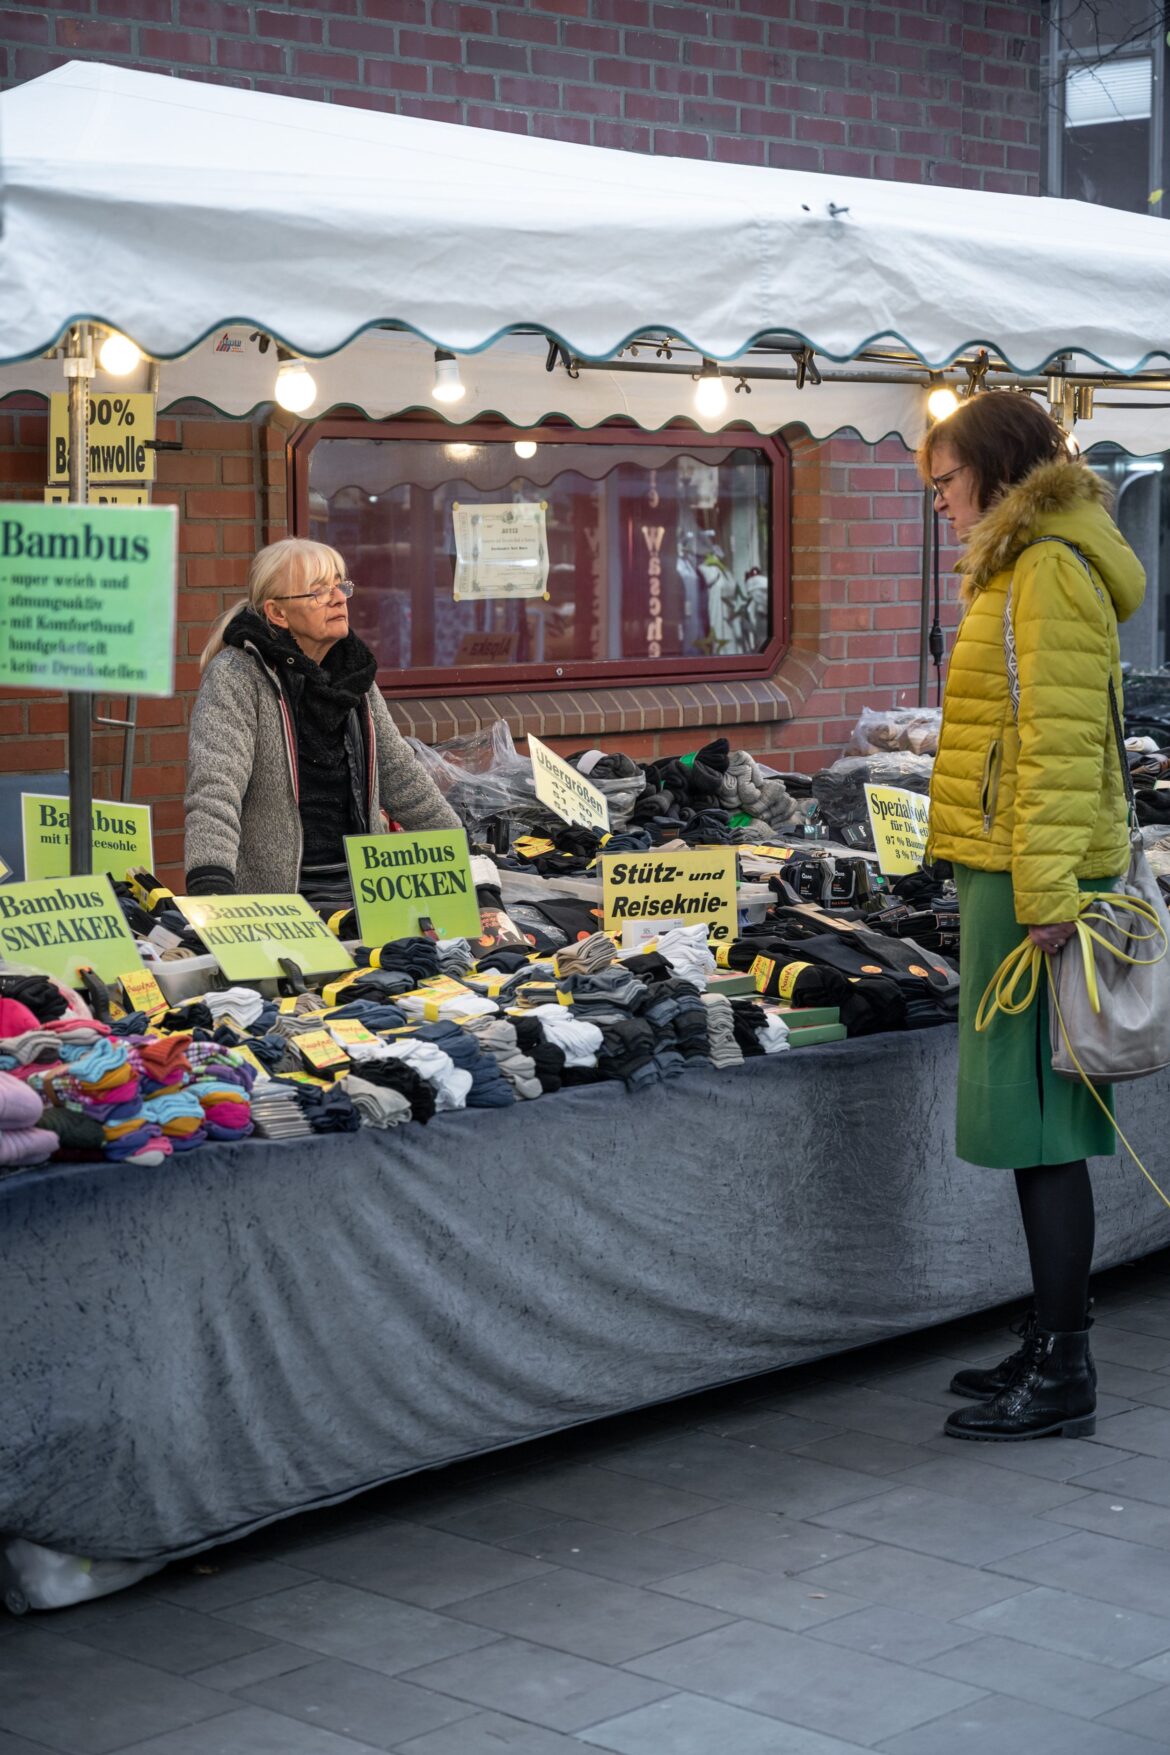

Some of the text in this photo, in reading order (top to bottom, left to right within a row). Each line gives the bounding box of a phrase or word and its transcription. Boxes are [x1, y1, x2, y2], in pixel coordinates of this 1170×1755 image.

[68, 399, 135, 426] 0%
[55, 436, 146, 474] Bmwolle
[1, 520, 150, 563] Bambus
[10, 574, 49, 590] super
[54, 574, 96, 589] weich
[100, 576, 129, 590] und
[8, 595, 103, 612] atmungsaktiv
[10, 616, 32, 629] mit
[36, 615, 135, 634] Komfortbund
[10, 659, 48, 674] keine
[52, 661, 147, 679] Druckstellen
[536, 748, 603, 815] Übergrößen
[39, 804, 137, 836] Babus
[871, 792, 929, 824] Spezialoc
[890, 819, 903, 831] für
[40, 833, 137, 852] mit Feesohle
[885, 835, 895, 845] 97
[361, 841, 456, 870] Bambus
[895, 849, 901, 859] 3
[360, 869, 467, 904] SOCKEN
[610, 862, 725, 886] Stütz- und
[0, 888, 104, 919] Bambus
[198, 901, 302, 921] Bambus
[611, 892, 728, 918] Reiseknie-
[1, 914, 126, 952] SNEAKER
[203, 921, 331, 946] KURZSCHAFT
